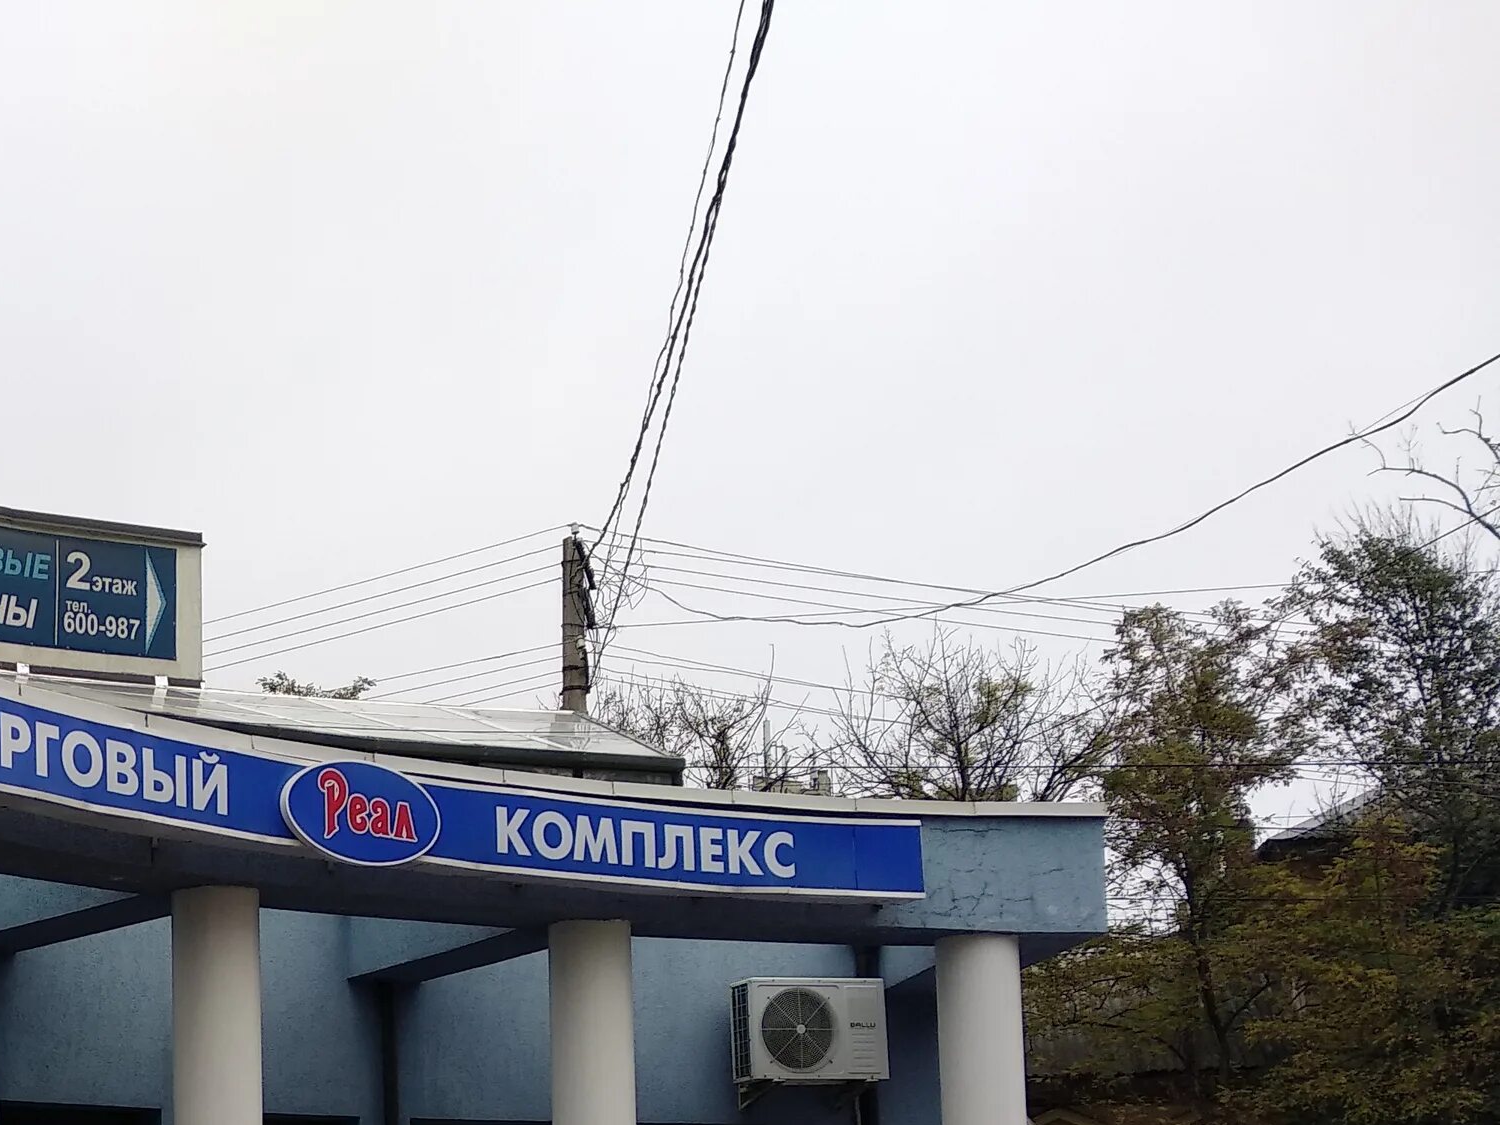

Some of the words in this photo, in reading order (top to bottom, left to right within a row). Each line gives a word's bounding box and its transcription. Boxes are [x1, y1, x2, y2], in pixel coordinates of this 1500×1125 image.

[65, 551, 91, 591] 2
[91, 576, 137, 596] этаж
[63, 611, 141, 640] 600-987
[65, 600, 92, 614] тел.
[317, 768, 419, 843] Реал
[495, 805, 796, 879] КОМПЛЕКС
